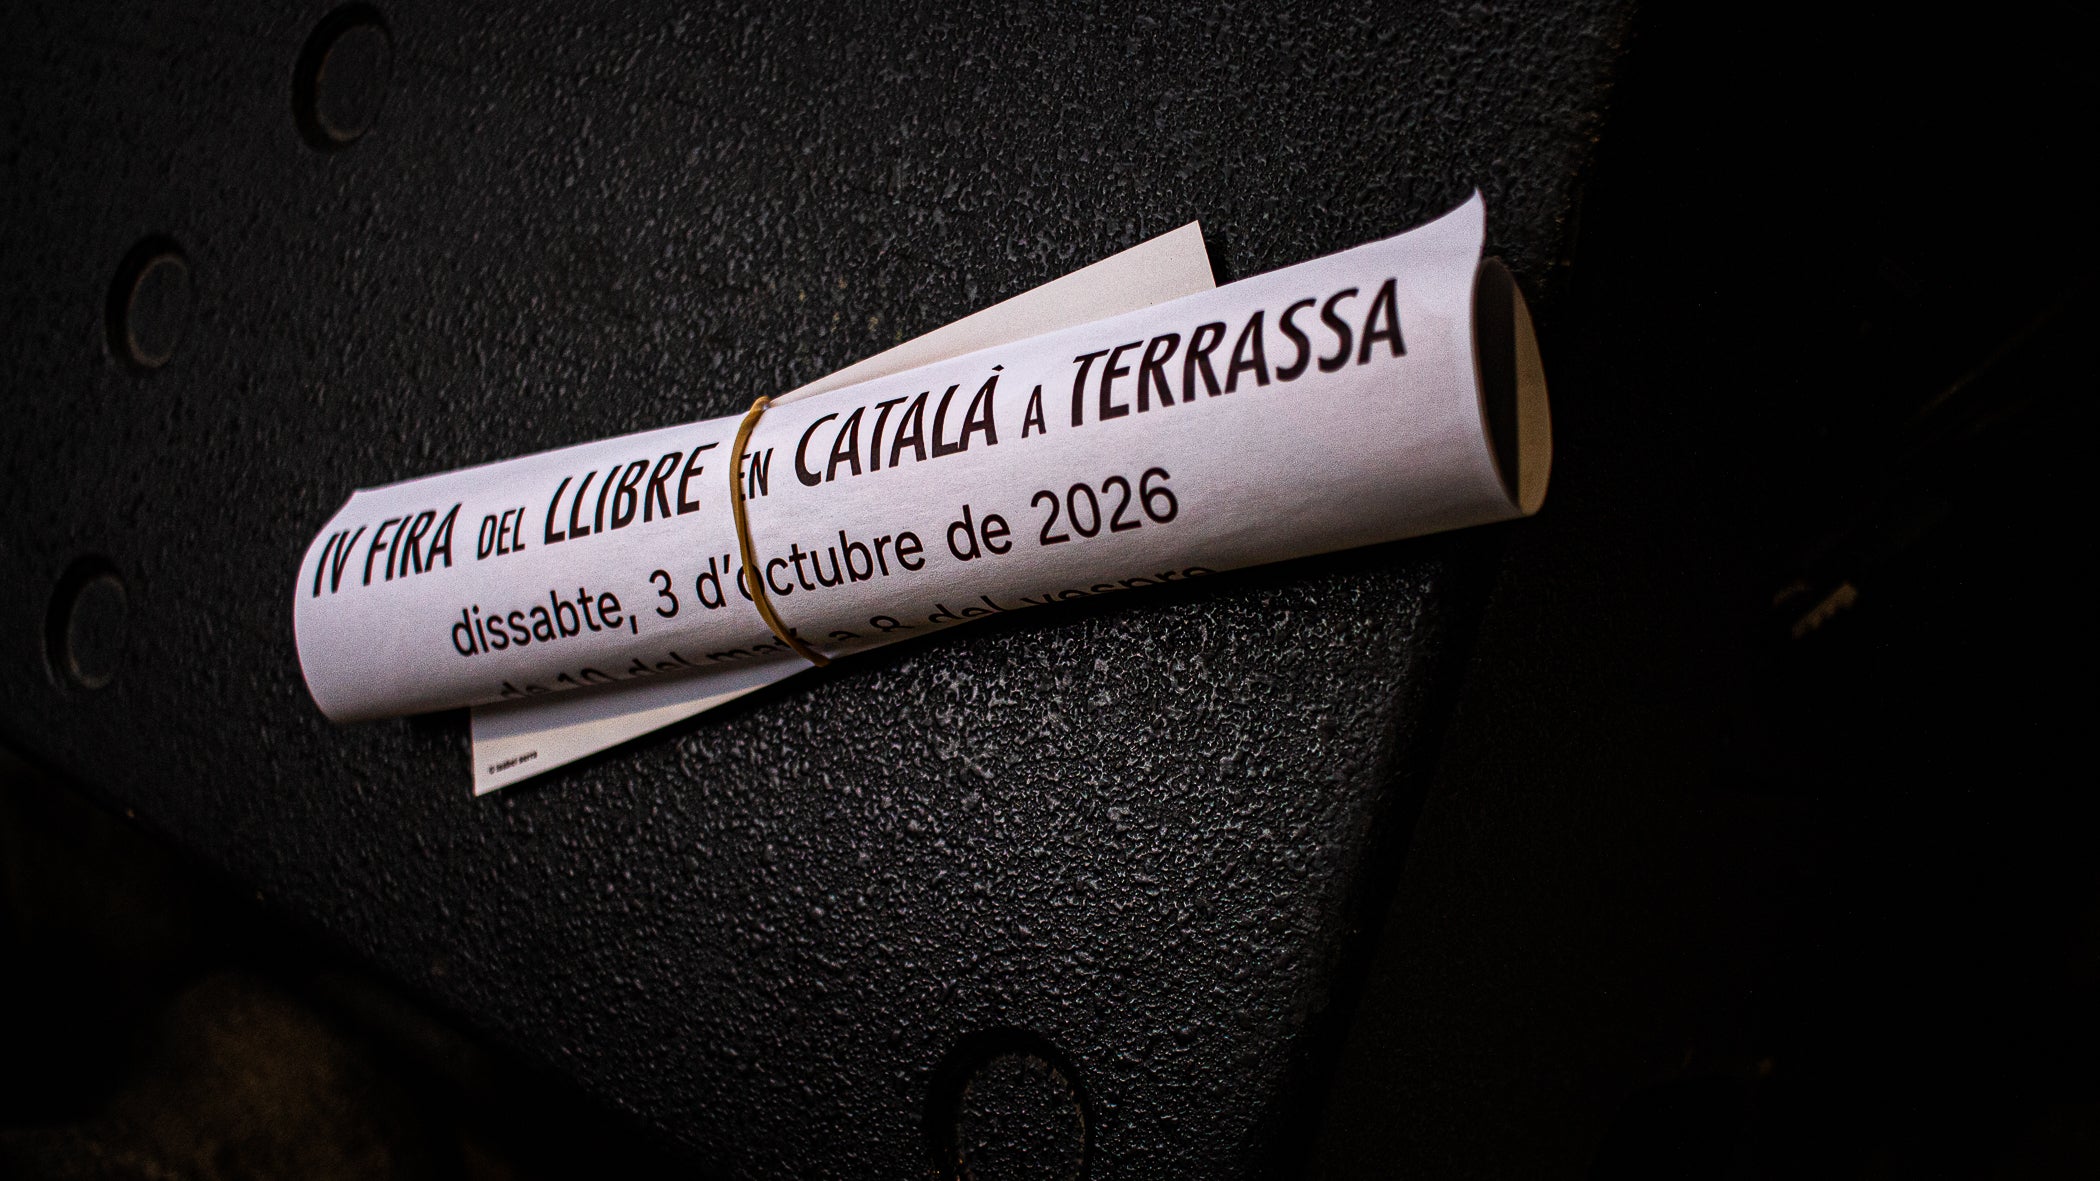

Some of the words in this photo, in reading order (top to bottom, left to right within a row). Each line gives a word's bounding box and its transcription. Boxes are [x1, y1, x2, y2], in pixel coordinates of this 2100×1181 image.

[312, 525, 367, 598] IV
[362, 502, 463, 588] FIRA
[476, 507, 526, 561] DEL
[543, 442, 720, 546] LLIBRE
[794, 364, 1005, 488] CATALÀ
[1021, 384, 1047, 438] A
[1070, 277, 1406, 427] TERRASSA
[450, 587, 638, 656] dissabte,
[648, 568, 680, 619] 3
[946, 504, 1012, 562] de
[1030, 466, 1180, 546] 2026
